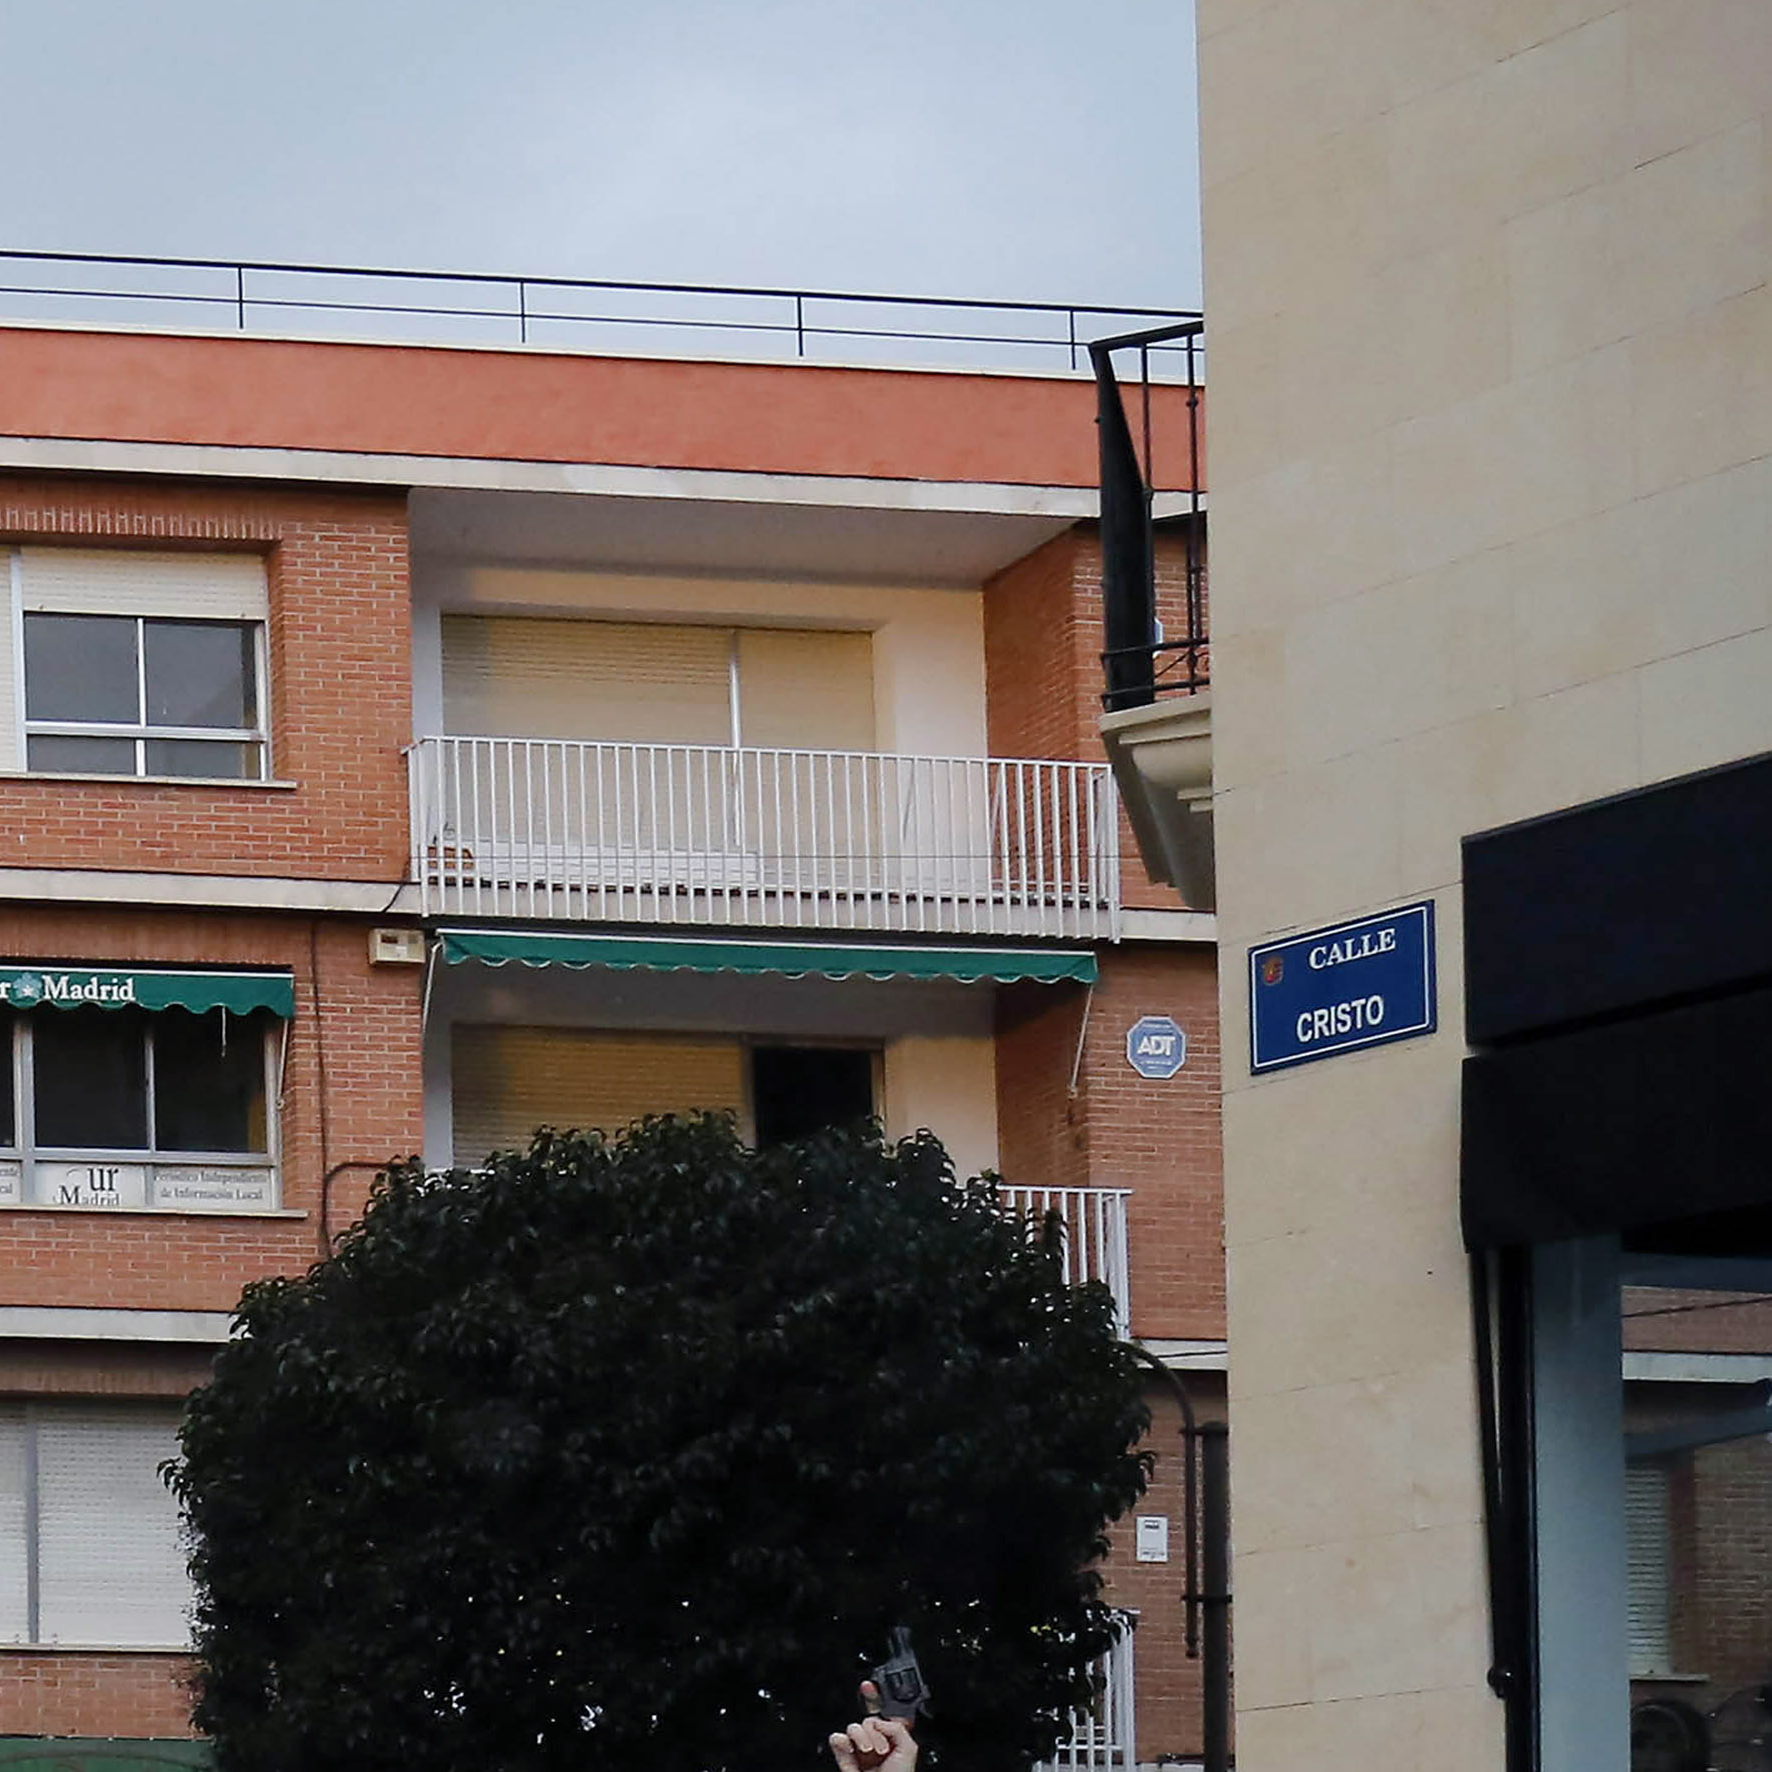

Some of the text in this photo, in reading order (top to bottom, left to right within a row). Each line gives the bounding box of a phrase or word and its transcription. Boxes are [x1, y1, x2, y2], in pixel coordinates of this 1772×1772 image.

[1307, 926, 1397, 971] CALLE
[41, 973, 136, 1003] Madrid
[1295, 994, 1386, 1044] CRISTO
[1137, 1035, 1176, 1056] ADT
